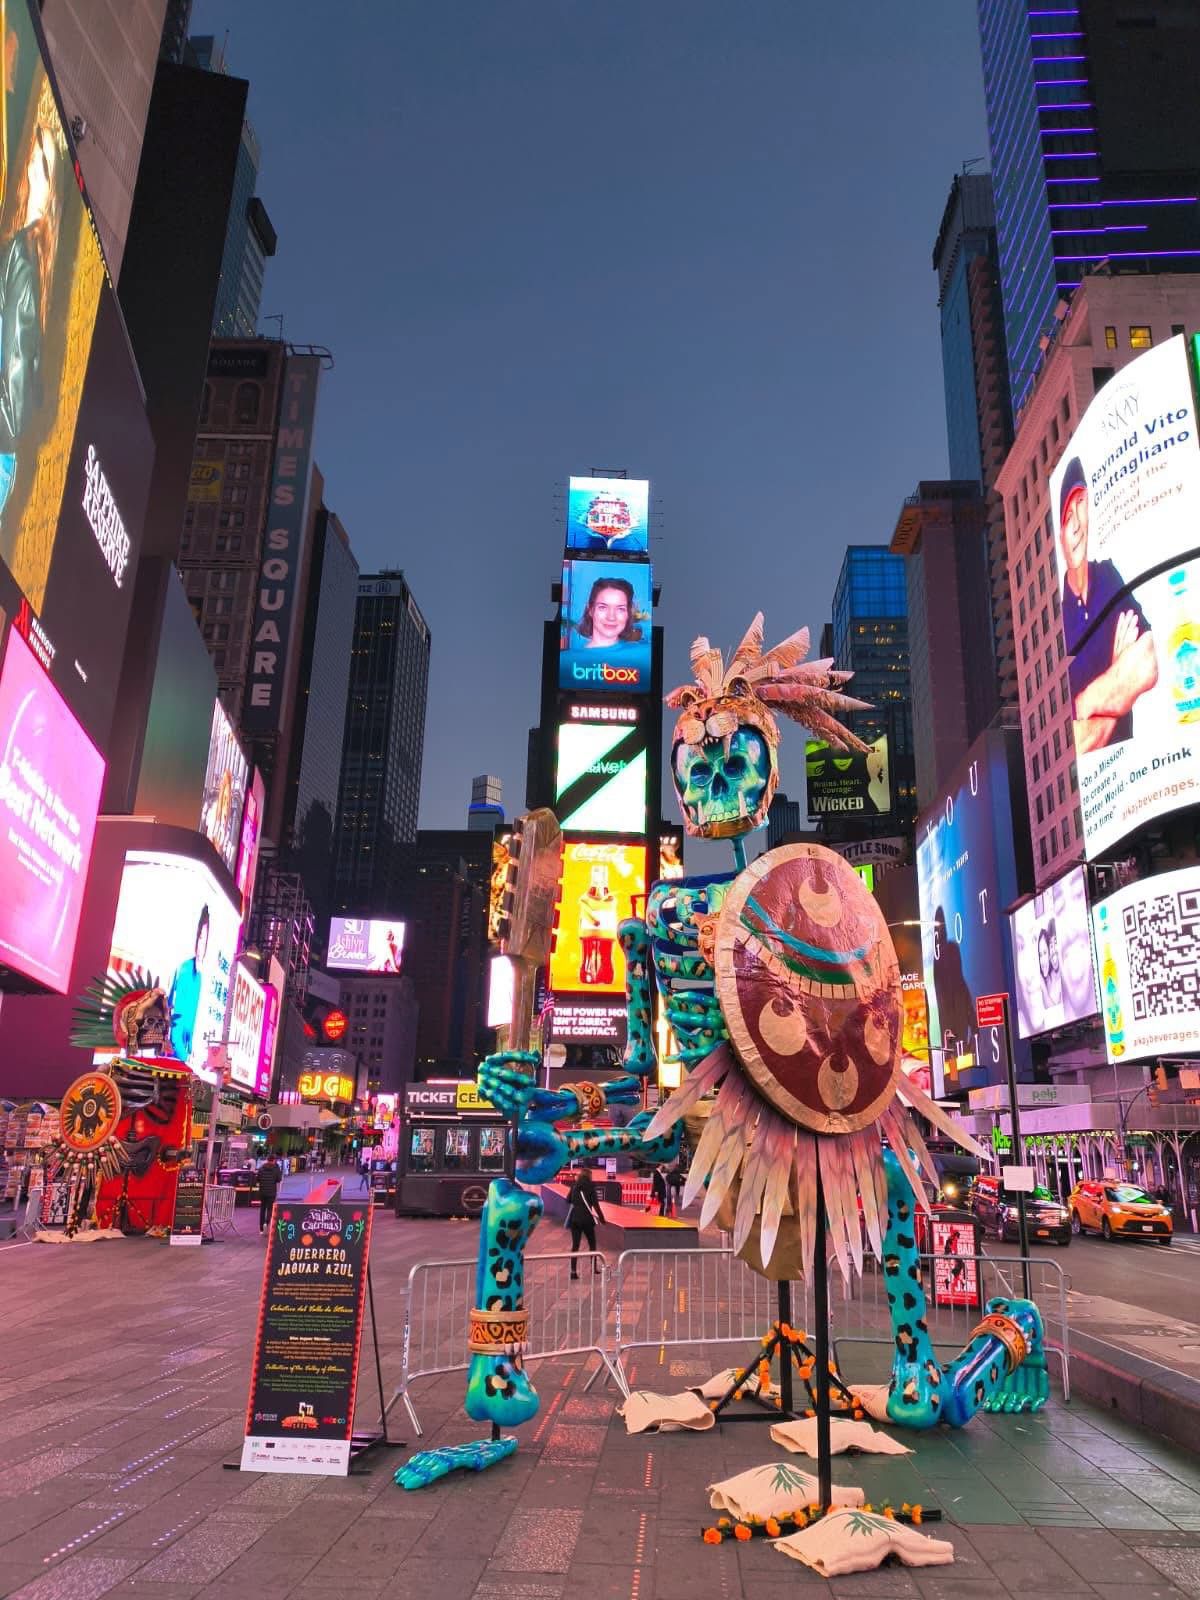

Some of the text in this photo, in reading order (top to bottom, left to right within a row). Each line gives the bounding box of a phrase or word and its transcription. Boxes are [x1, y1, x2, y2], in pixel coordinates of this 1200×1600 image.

[1091, 407, 1188, 488] Reynald Vito
[1093, 431, 1190, 507] Grattagliano
[84, 444, 131, 567] SAPPHIRE
[1124, 483, 1184, 523] Category
[82, 477, 124, 589] RESERVE
[250, 528, 290, 707] SQUARE
[573, 662, 638, 682] britbox
[571, 706, 637, 720] SAMSUNG
[1099, 746, 1125, 773] Mission
[1084, 800, 1104, 821] Better
[1104, 780, 1125, 804] World
[1129, 766, 1149, 784] One
[1152, 747, 1193, 771] Drink
[1090, 776, 1111, 800] create
[843, 842, 873, 859] ITTLE
[932, 888, 988, 961] GOT
[900, 973, 919, 982] ACE
[902, 982, 926, 991] GARD
[553, 1007, 629, 1018] THE POWER MOV
[578, 1017, 613, 1026] DIRECT
[552, 1026, 618, 1036] EYE CONTACT.
[407, 1091, 457, 1104] TICKET
[301, 1221, 339, 1232] Catrinas
[289, 1248, 346, 1262] GUERRERO
[277, 1262, 354, 1278] JAGUAR AZUL
